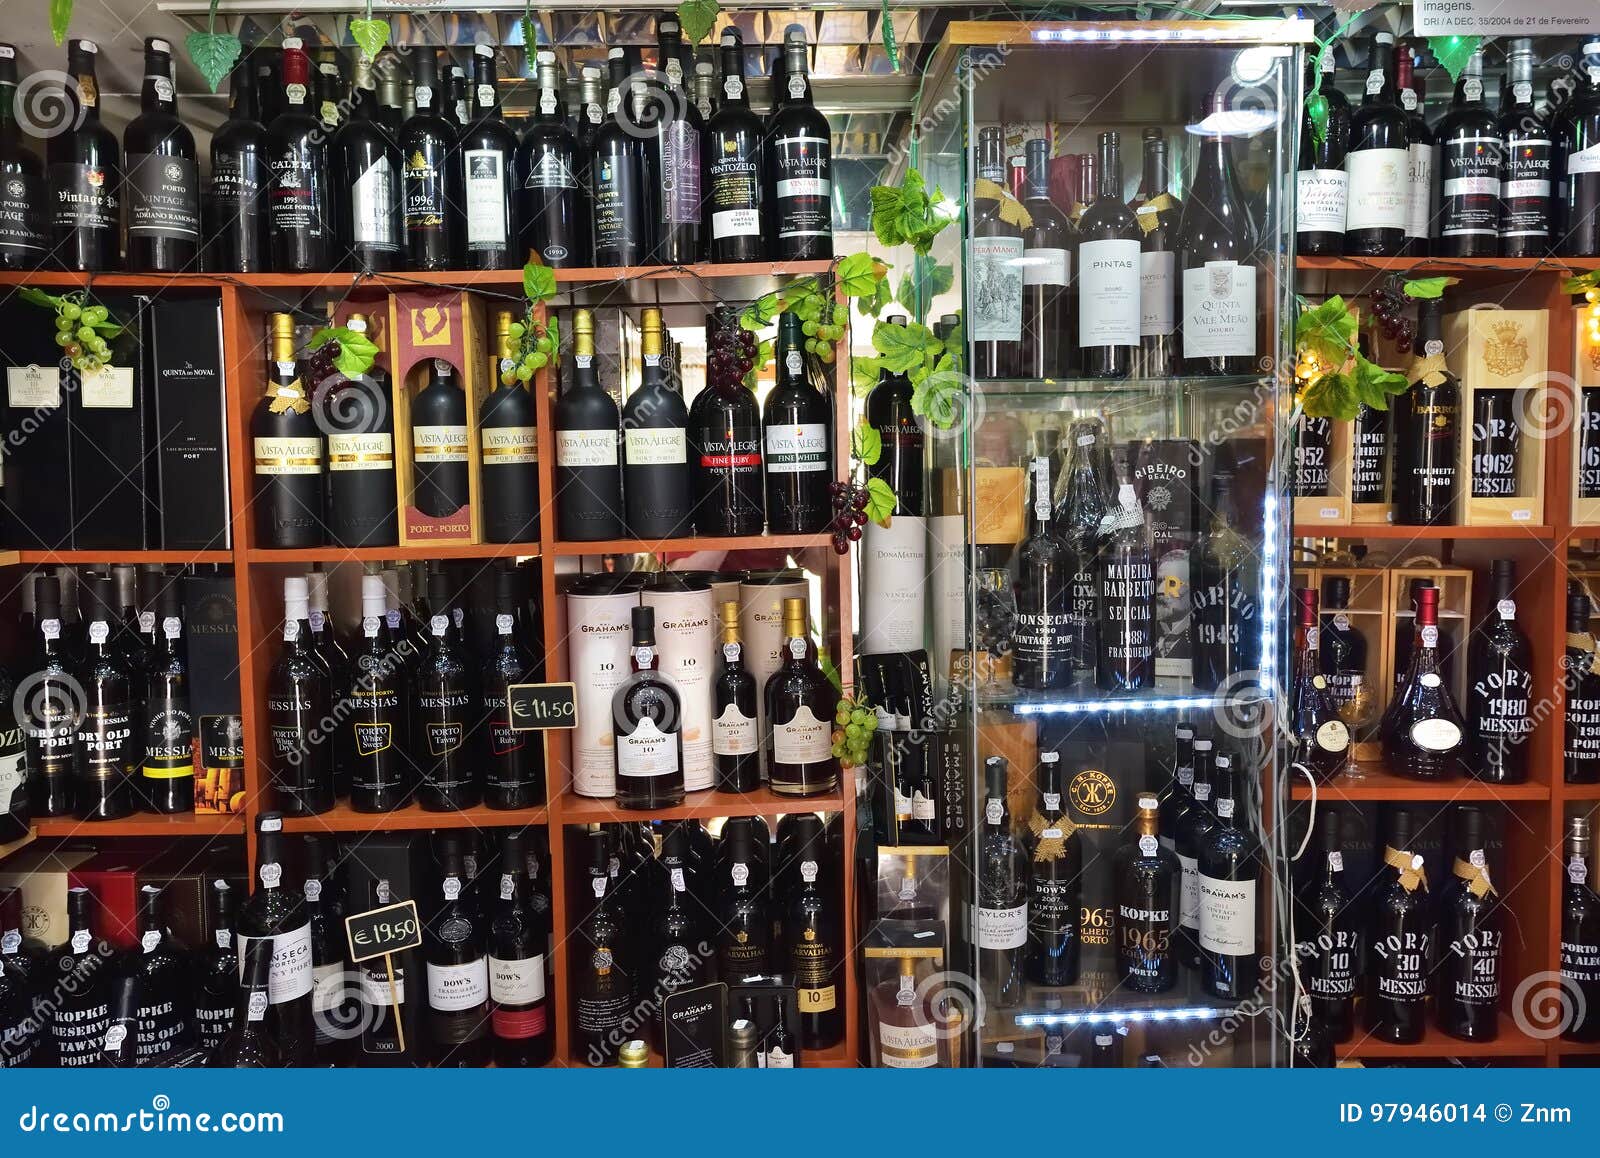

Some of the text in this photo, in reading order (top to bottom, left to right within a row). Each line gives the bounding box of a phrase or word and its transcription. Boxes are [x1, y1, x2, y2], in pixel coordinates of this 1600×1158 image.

[1423, 0, 1475, 13] imagens.
[1478, 17, 1511, 26] 35/2004
[1513, 16, 1524, 26] de
[1526, 16, 1537, 25] 21
[1538, 16, 1549, 25] de
[1550, 16, 1590, 25] Fevereiro
[779, 157, 828, 169] VISTA ALEGRE
[1450, 157, 1473, 168] VISTA
[1523, 159, 1551, 170] ALEGRE
[710, 162, 757, 175] VENTOZELO
[794, 168, 814, 176] PORTO
[1467, 167, 1489, 175] PORTO
[1516, 170, 1538, 178] PORTO
[162, 184, 187, 193] PORTO
[58, 190, 104, 207] Vintage
[142, 194, 185, 206] VINTAGE
[410, 195, 434, 207] 1996
[3, 200, 30, 209] PORTO
[1092, 259, 1133, 271] PINTAS
[1200, 300, 1242, 312] QUINTA
[1192, 315, 1218, 326] VALE
[1208, 326, 1235, 334] DOURO
[162, 369, 216, 377] QUINTA NOVAL
[419, 433, 440, 443] VISTA
[488, 435, 511, 445] VISTA
[703, 439, 758, 453] VISTA ALEGRE
[771, 437, 826, 451] VISTA ALEGRE
[260, 445, 317, 456] VISTA ALEGRE
[712, 455, 750, 465] FINE RUBY
[778, 453, 820, 463] FINE WHITE
[1472, 454, 1514, 475] 1962
[1134, 462, 1187, 484] RIBEIRO
[1147, 472, 1172, 482] REAL
[409, 524, 469, 535] PORT PORTO
[1107, 563, 1153, 580] MADEIRA
[1103, 579, 1156, 599] BARBEITO
[581, 622, 630, 634] GRAHAM'S
[662, 618, 709, 631] GRAHAM'S
[1014, 634, 1074, 646] VINTAGE PORT
[1119, 629, 1143, 646] 1988
[1108, 646, 1152, 659] FRASQUEIRA
[682, 657, 697, 667] 10
[599, 663, 615, 673] 10
[420, 695, 470, 710] MESSIAS
[1487, 698, 1528, 716] 1980
[718, 721, 750, 730] GRAHAM'S
[785, 725, 823, 735] GRAHAM'S
[78, 727, 132, 744] DRY OLD
[357, 726, 388, 737] PORTO
[430, 726, 461, 737] PORTO
[728, 728, 740, 736] 20
[361, 733, 383, 744] White
[434, 736, 458, 746] Tawny
[499, 736, 518, 746] Ruby
[628, 736, 667, 747] GRAHAM'S
[86, 738, 123, 752] PORT
[362, 741, 384, 750] Sweet
[642, 746, 655, 754] 10
[1035, 884, 1067, 896] DOW'S
[1200, 886, 1248, 901] GRAHAM'S
[1033, 903, 1070, 912] VINTAGE
[1119, 904, 1169, 922] KOPKE
[1205, 906, 1238, 916] VINTAGE
[1041, 912, 1062, 920] PORT
[1211, 913, 1232, 921] PORT
[1122, 926, 1171, 951] 1965
[1469, 949, 1490, 957] MAIS
[1560, 941, 1598, 954] PORTO
[1330, 952, 1350, 971] 10
[1397, 953, 1421, 971] 30
[1473, 958, 1496, 975] 40
[495, 972, 521, 981] DOW'S
[1128, 967, 1160, 978] PORTO
[1328, 970, 1351, 979] ANOS
[1396, 971, 1421, 980] ANOS
[443, 976, 472, 988] DOW'S
[1473, 975, 1495, 983] ANOS
[807, 990, 821, 1004] 10
[54, 1003, 109, 1023] KOPKE
[672, 1003, 713, 1020] GRAHAM'S
[138, 1020, 156, 1031] 10
[58, 1034, 106, 1052] TAWNY
